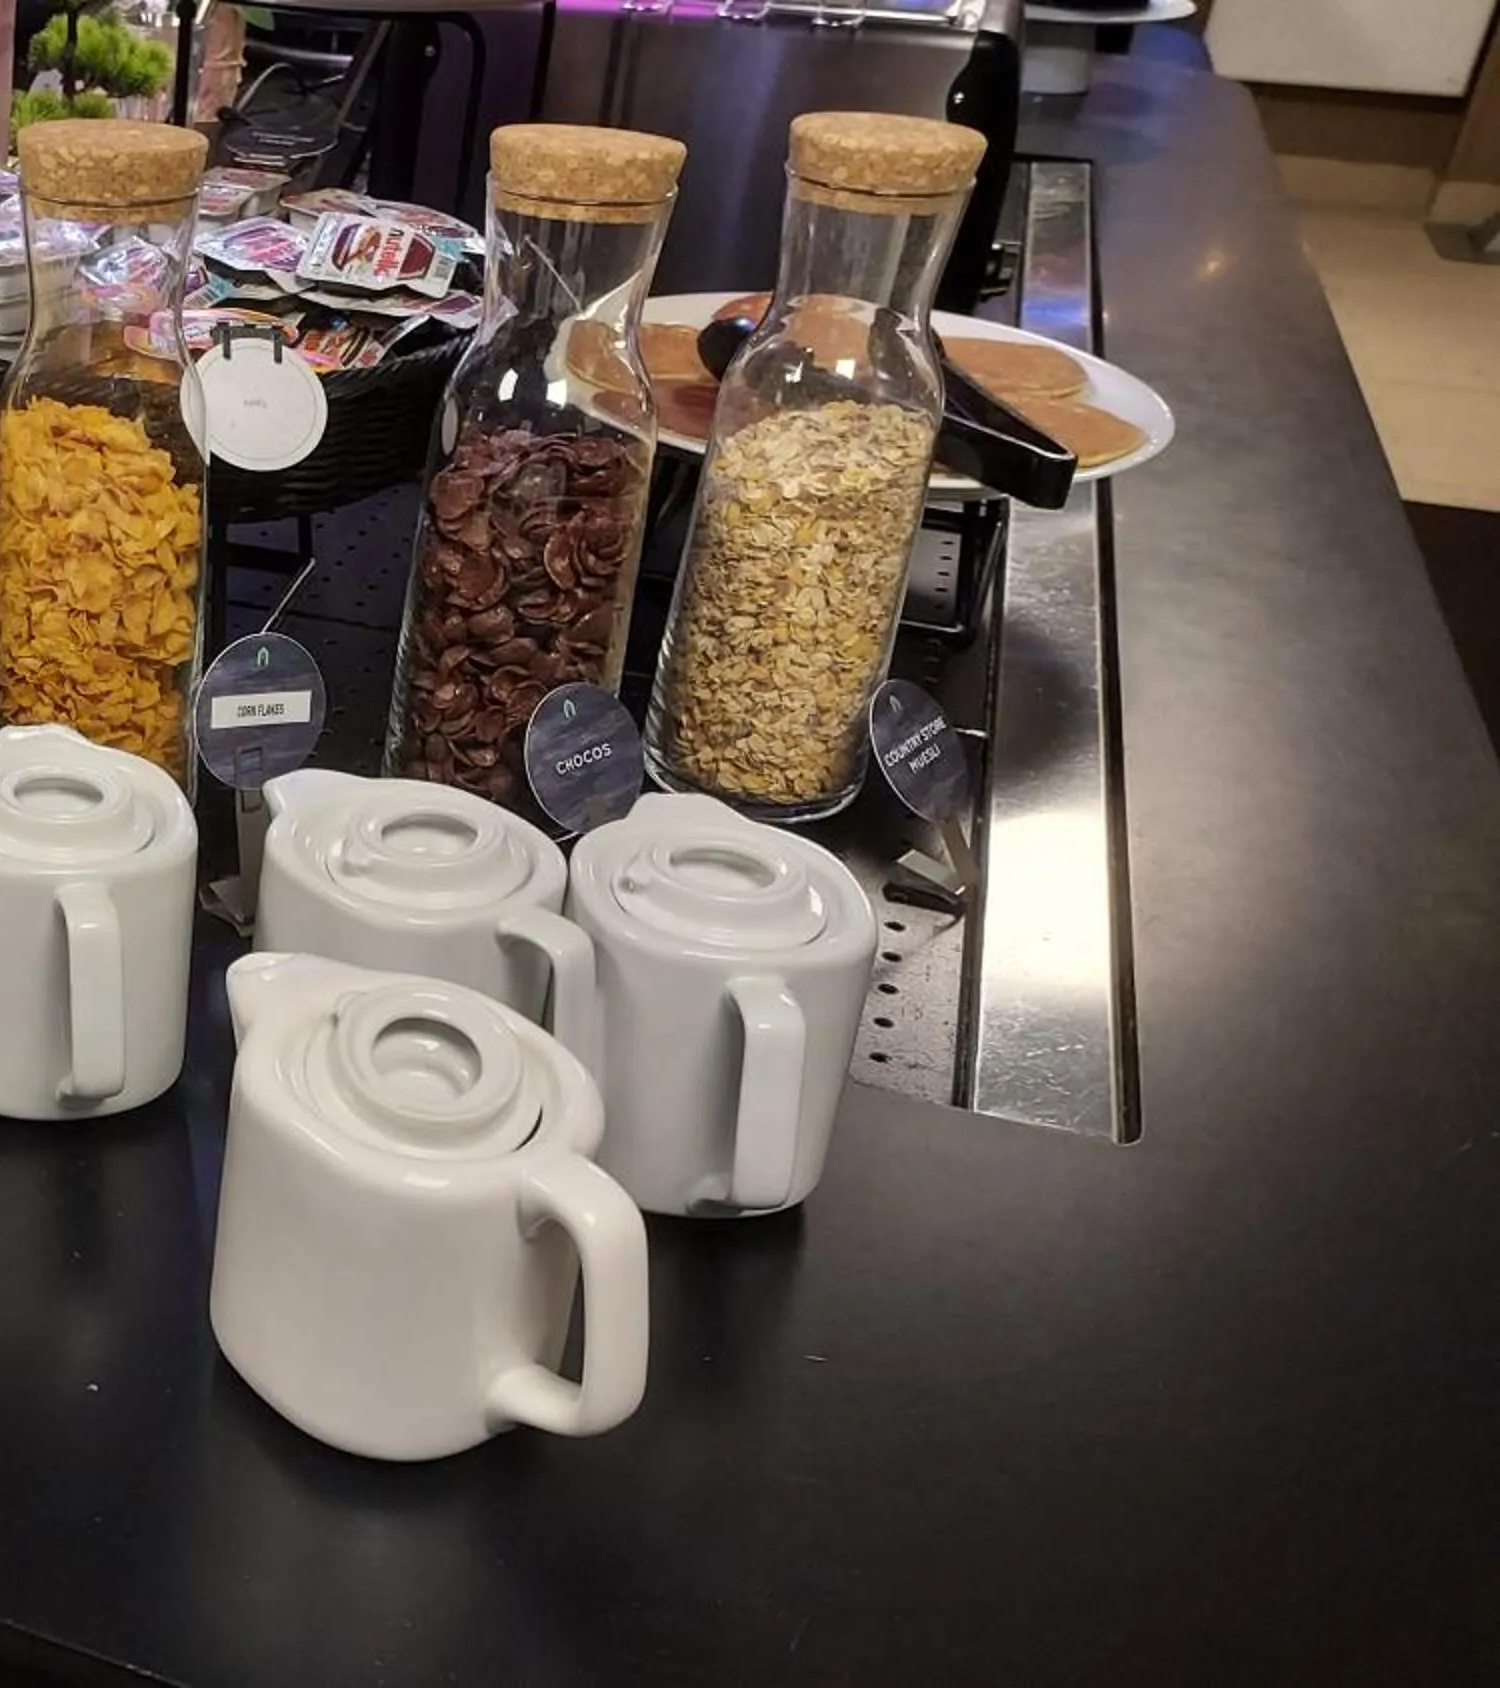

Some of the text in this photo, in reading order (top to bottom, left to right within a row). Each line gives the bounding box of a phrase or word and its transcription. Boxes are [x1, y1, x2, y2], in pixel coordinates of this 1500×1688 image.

[237, 703, 285, 718] CORN FLAKES
[555, 743, 612, 775] CHOCOS
[883, 731, 923, 767] COUNTRY
[908, 743, 941, 774] MUESLI
